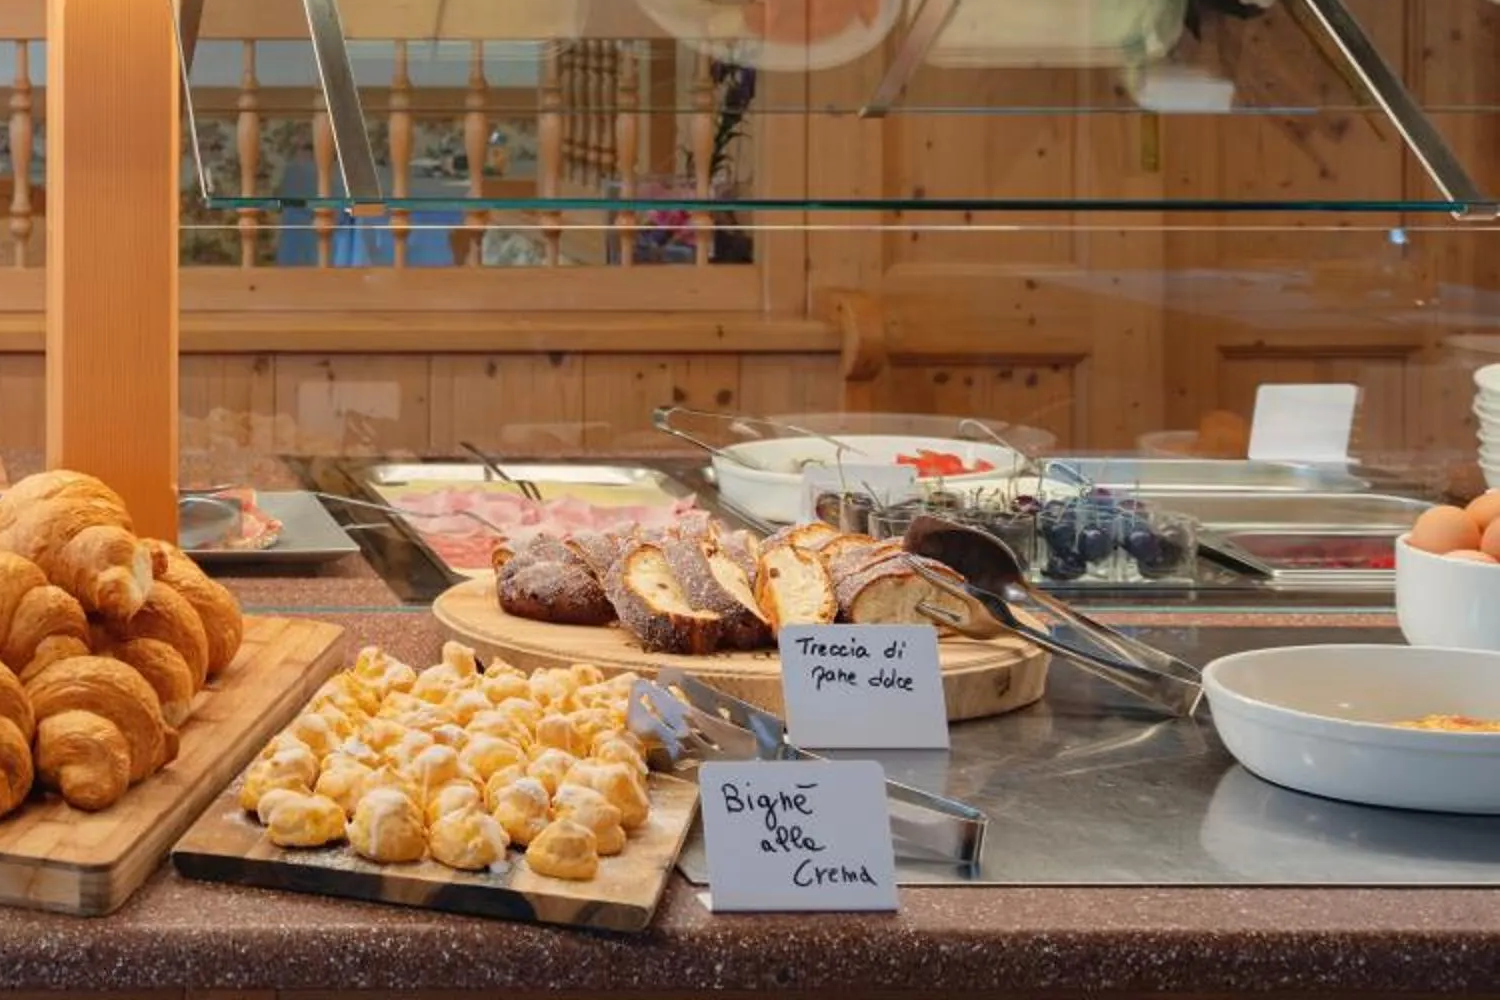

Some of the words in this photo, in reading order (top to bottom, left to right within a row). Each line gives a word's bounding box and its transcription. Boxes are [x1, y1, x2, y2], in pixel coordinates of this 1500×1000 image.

[796, 637, 870, 659] Treccia
[883, 640, 907, 659] di
[811, 665, 858, 691] pane
[760, 825, 827, 853] alla
[792, 858, 879, 888] Crema
